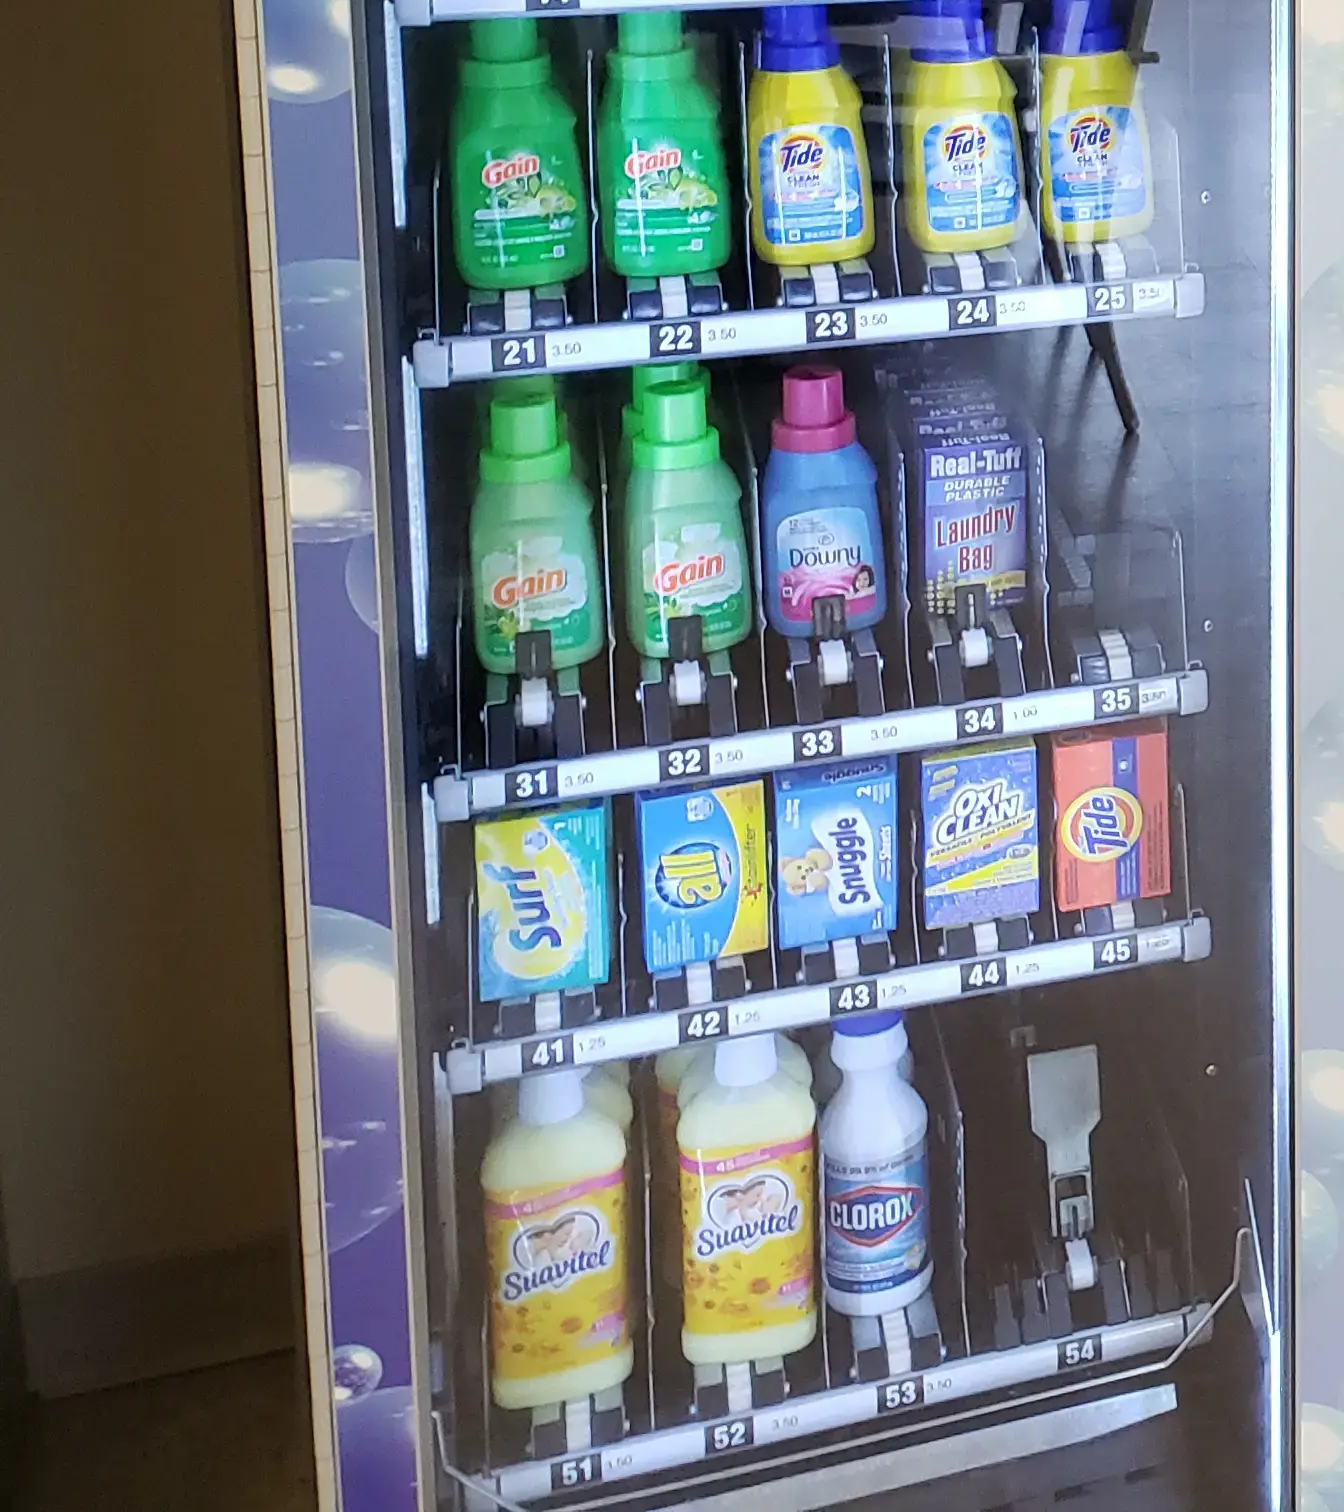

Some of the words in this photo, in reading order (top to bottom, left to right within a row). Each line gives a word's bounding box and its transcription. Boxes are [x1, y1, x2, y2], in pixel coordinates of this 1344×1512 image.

[945, 131, 985, 161] Tide
[1070, 123, 1110, 152] Tide
[482, 155, 539, 187] Gain
[625, 149, 681, 178] Gain
[780, 143, 823, 172] Tide
[956, 298, 990, 324] 24
[1095, 286, 1126, 311] 25
[659, 324, 693, 351] 22
[815, 311, 849, 337] 23
[503, 337, 537, 364] 21
[931, 447, 1022, 477] Real-Tuff
[944, 476, 1010, 491] DURABLE
[945, 487, 1004, 502] PLASTIC
[937, 505, 1016, 547] Laundry
[790, 545, 861, 567] Downy
[960, 544, 992, 574] Bag
[655, 554, 723, 592] Gain
[493, 570, 565, 606] Gain
[1101, 690, 1133, 713] 35
[963, 708, 996, 733] 34
[801, 730, 835, 756] 33
[667, 749, 702, 774] 32
[516, 770, 549, 797] 31
[954, 781, 1004, 814] OXI
[935, 797, 1024, 845] CLEAN
[1081, 795, 1129, 858] Tide
[835, 816, 871, 906] Snuggle
[482, 862, 562, 950] Surf
[1101, 938, 1131, 962] 45
[969, 961, 999, 986] 44
[838, 985, 870, 1009] 43
[687, 1011, 720, 1036] 42
[532, 1040, 565, 1065] 41
[829, 1192, 917, 1230] CLOROX
[697, 1206, 800, 1258] Suavitel
[503, 1240, 610, 1302] Suavitel
[1064, 1341, 1096, 1365] 54
[884, 1381, 918, 1407] 53
[712, 1423, 746, 1448] 52
[559, 1457, 592, 1484] 51
